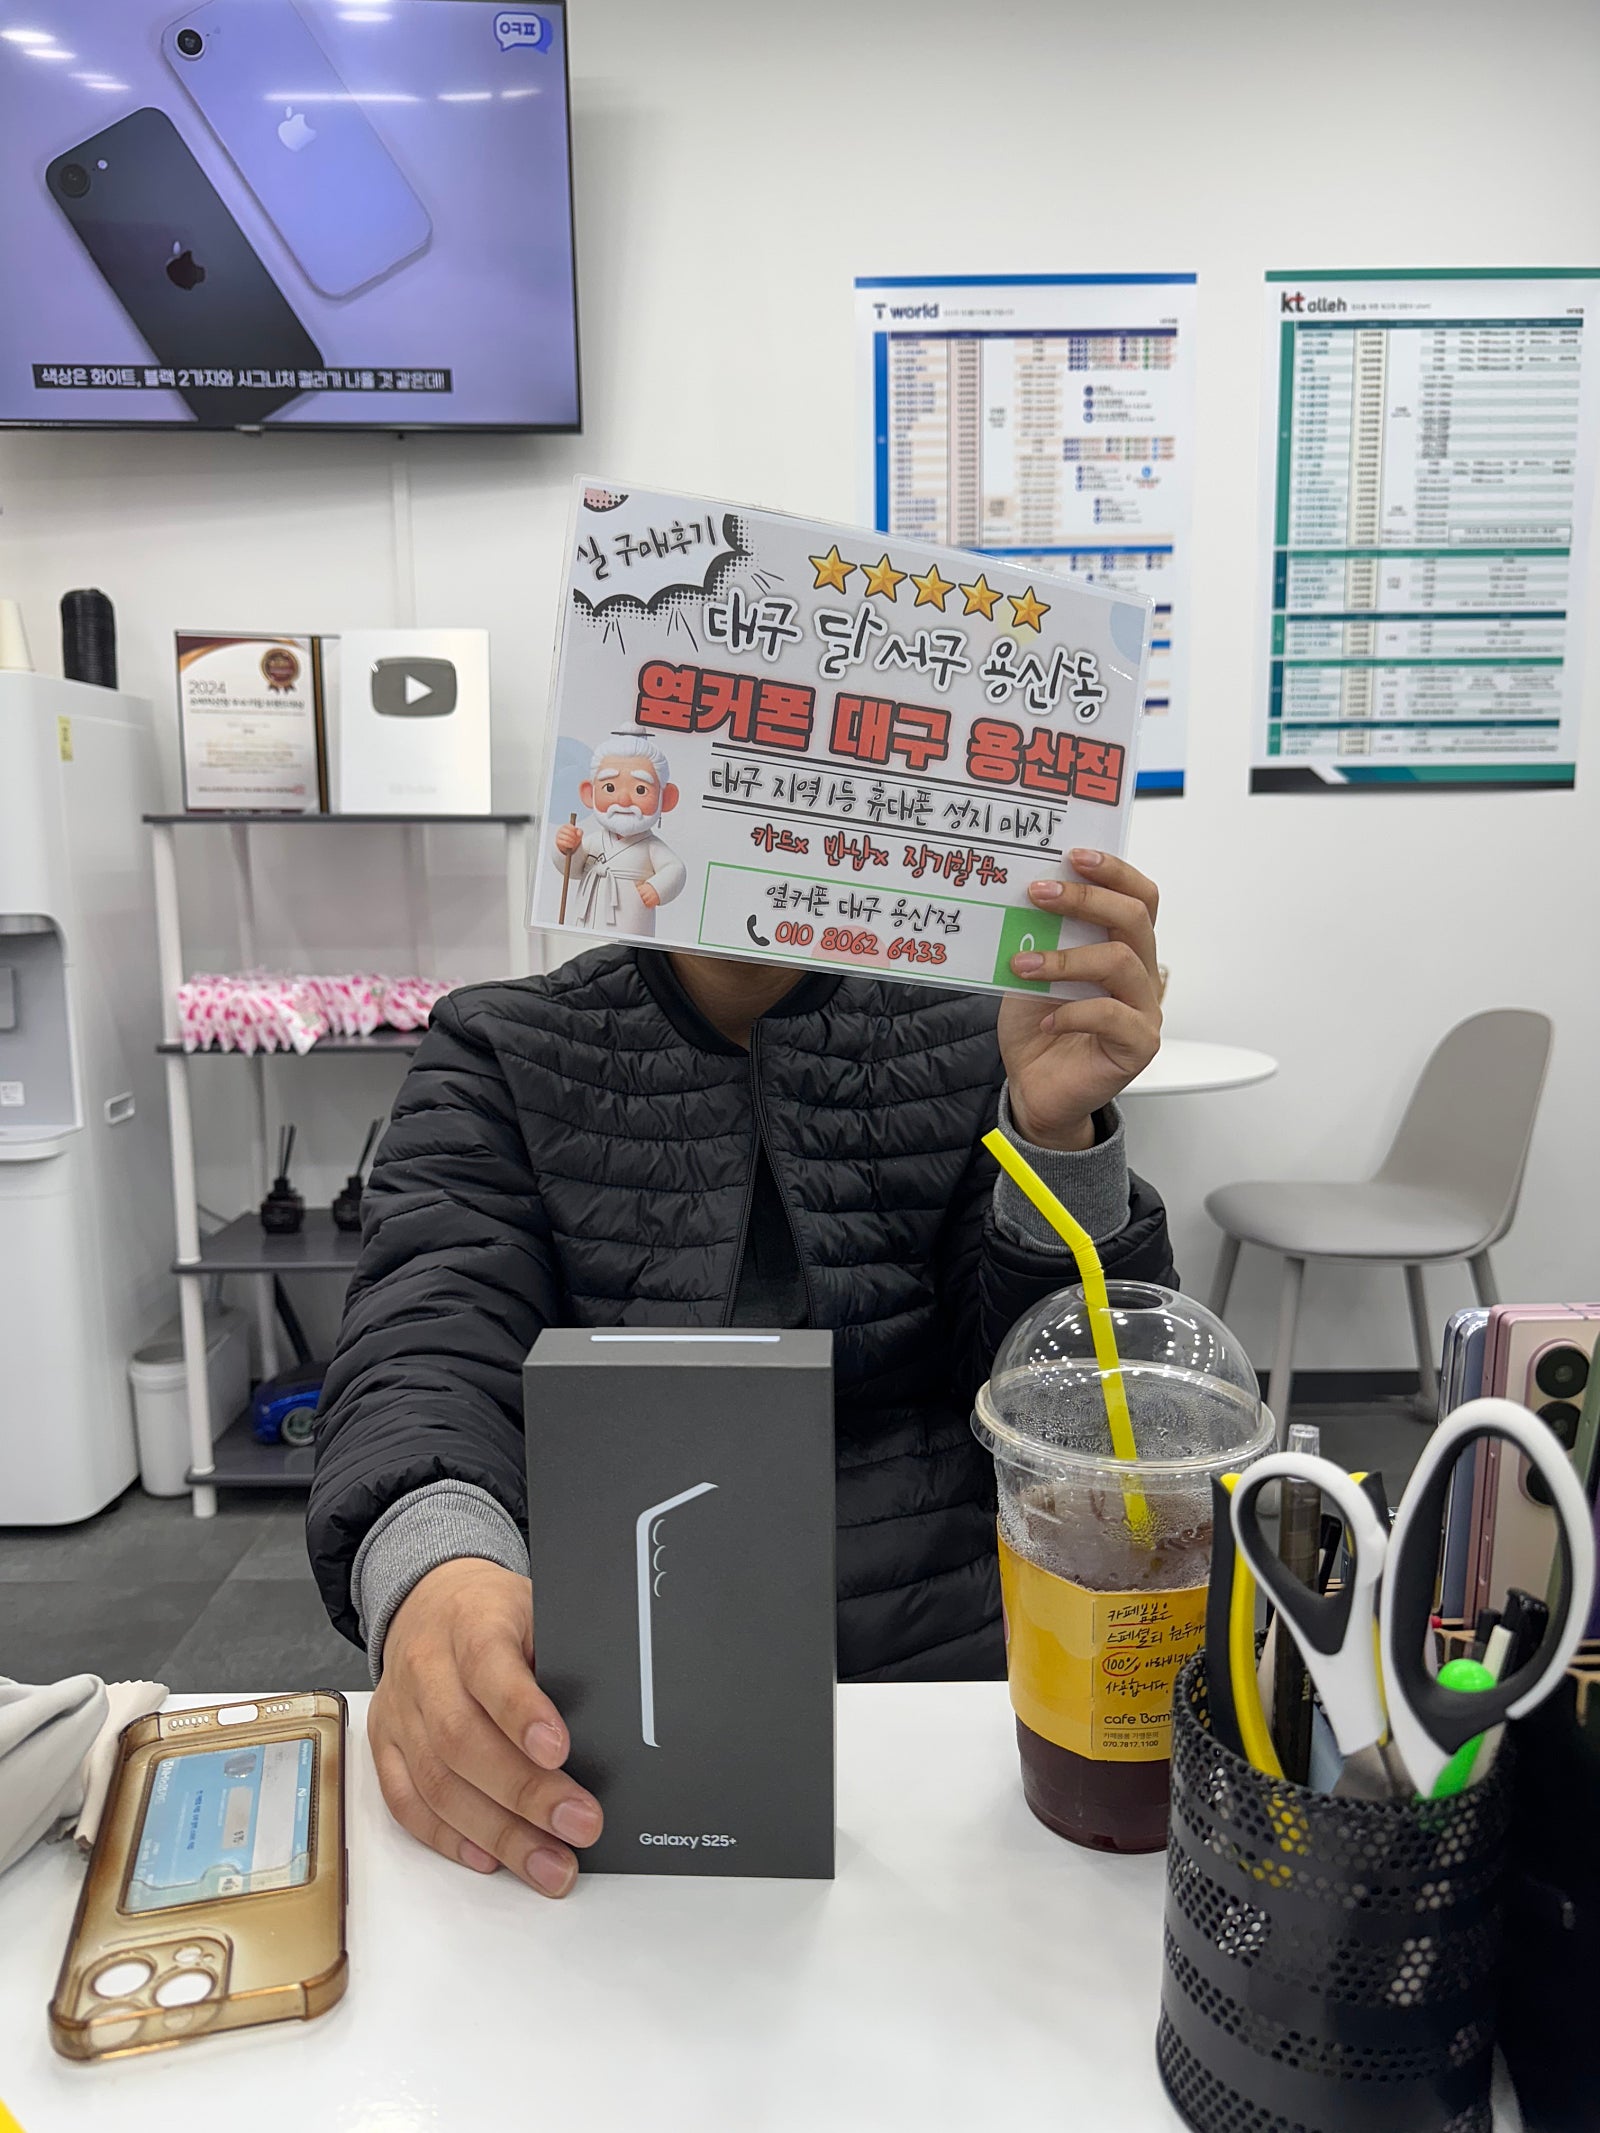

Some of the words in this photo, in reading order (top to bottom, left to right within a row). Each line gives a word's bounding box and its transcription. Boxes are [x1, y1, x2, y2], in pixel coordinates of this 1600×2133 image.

[873, 303, 886, 319] T
[890, 303, 939, 318] world
[1281, 292, 1304, 313] kt
[1307, 297, 1347, 313] olleh
[41, 367, 88, 386] 색상은
[90, 368, 142, 388] 화이트,
[144, 369, 175, 387] 블랙
[178, 369, 234, 387] 2가지와
[237, 369, 296, 388] 시그니처
[298, 370, 343, 389] 컬러가
[345, 371, 375, 389] 나올
[377, 371, 394, 389] 것
[577, 536, 609, 580] 실
[615, 515, 716, 567] 구매후기
[708, 593, 798, 656] 대구
[983, 642, 1102, 719] 용산동
[189, 681, 227, 695] 2024
[635, 660, 816, 752] 옆커폰
[829, 691, 951, 771] 대구
[966, 717, 1126, 806] 용산점
[711, 762, 763, 798] 대구
[773, 773, 821, 807] 지역
[828, 780, 856, 812] 1등
[866, 780, 934, 827] 휴대폰
[943, 800, 991, 833] 성지
[1000, 808, 1062, 847] 매장
[765, 883, 830, 917] 옆커폰
[838, 893, 882, 923] 대구
[890, 899, 960, 934] 용산점
[775, 921, 814, 946] 010
[820, 927, 879, 955] 8062
[887, 937, 947, 965] 6433
[1107, 1602, 1173, 1624] 카페봄봄은
[1106, 1627, 1163, 1648] 스페셜티
[1106, 1656, 1140, 1672] 100%
[1145, 1649, 1198, 1668] 아라비카
[1105, 1678, 1169, 1698] 사용합니다.
[1104, 1713, 1136, 1725] cafe
[1140, 1711, 1173, 1725] Bom
[639, 1832, 699, 1849] Galaxy
[701, 1834, 737, 1847] S25+
